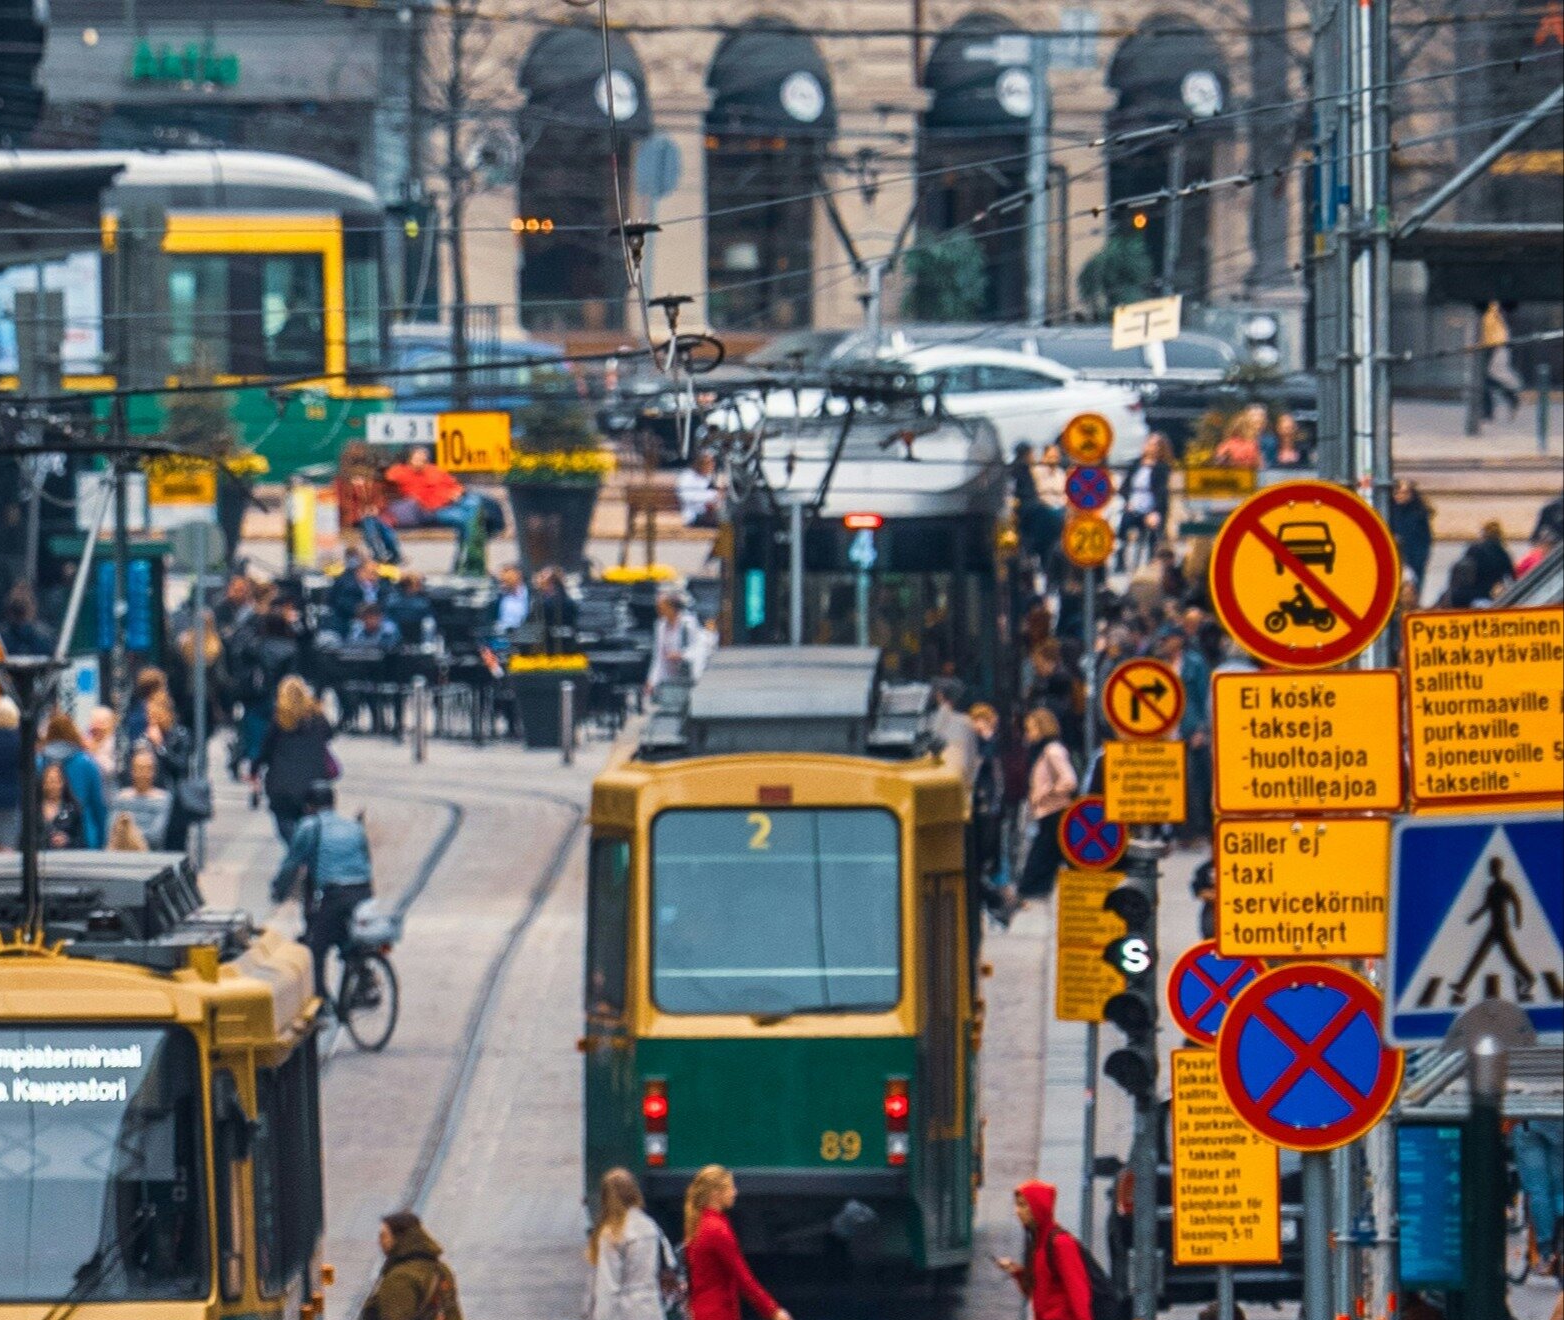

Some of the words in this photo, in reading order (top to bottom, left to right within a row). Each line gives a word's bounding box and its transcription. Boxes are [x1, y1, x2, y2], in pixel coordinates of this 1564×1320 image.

[440, 429, 465, 466] 10
[1412, 617, 1560, 643] Pysäyttäminen
[1415, 672, 1484, 693] sallittu
[1240, 687, 1260, 709] Ei
[1271, 687, 1336, 708] koske
[1242, 716, 1333, 740] -takseja
[1424, 719, 1520, 744] purkaville
[1242, 746, 1368, 771] -huoltoajoa
[1425, 743, 1544, 769] ajoneuvoille
[1243, 775, 1377, 800] -tontilleajoa
[745, 813, 773, 850] 2
[1224, 832, 1287, 855] Gäller
[1299, 833, 1319, 857] ej
[1223, 862, 1273, 884] -taxi
[1224, 890, 1385, 915] -servicekörnin
[1120, 938, 1152, 974] S
[13, 1076, 127, 1107] Kauppatori
[820, 1131, 862, 1161] 89
[1181, 1183, 1219, 1195] stanna
[1240, 1213, 1261, 1225] och
